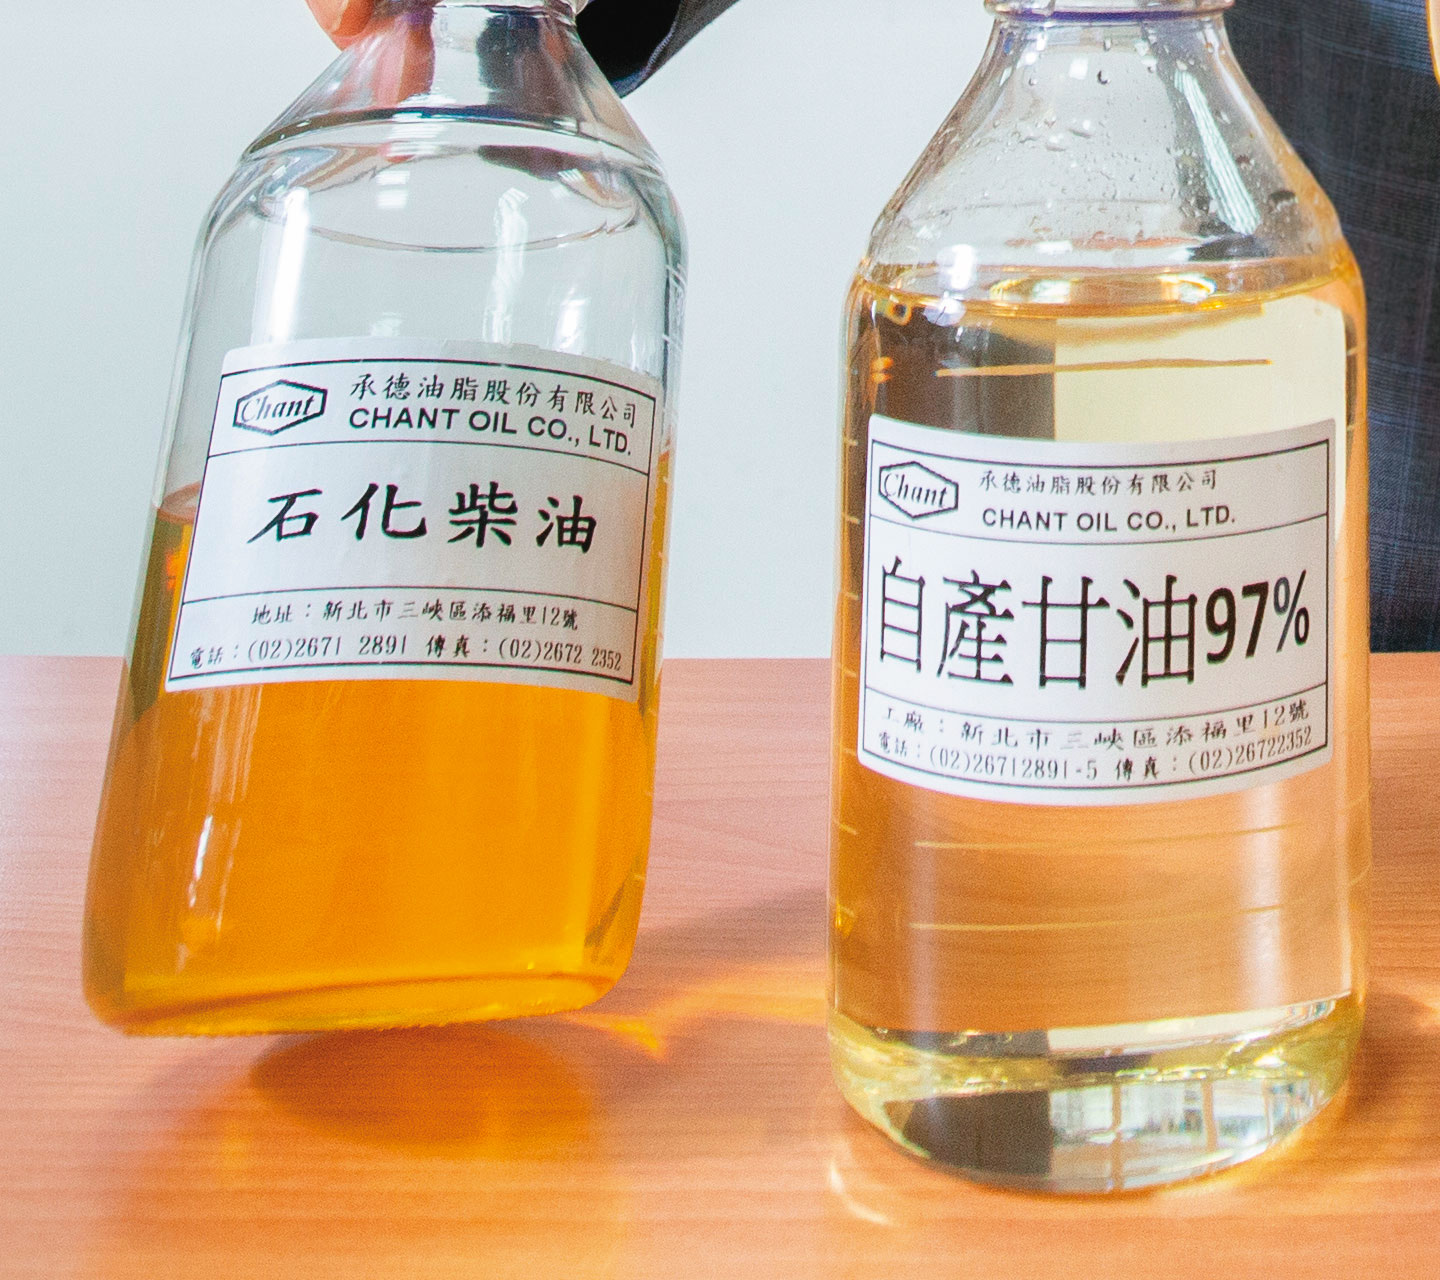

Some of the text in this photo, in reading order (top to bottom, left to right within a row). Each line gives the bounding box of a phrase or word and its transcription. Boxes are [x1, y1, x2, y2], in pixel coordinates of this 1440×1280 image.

[239, 392, 316, 425] Chant
[349, 373, 637, 430] 承德油脂股份有限公司
[348, 405, 633, 457] CHANT OIL CO., LTD.
[882, 471, 950, 510] Chant
[978, 468, 1218, 497] 承德油脂股份有限公司
[246, 480, 598, 554] 石化柴油
[981, 504, 1237, 533] CHANT OIL CO., LTD.
[879, 556, 1310, 692] 自產甘油97%
[358, 634, 408, 656] 2891
[591, 646, 623, 672] 2352
